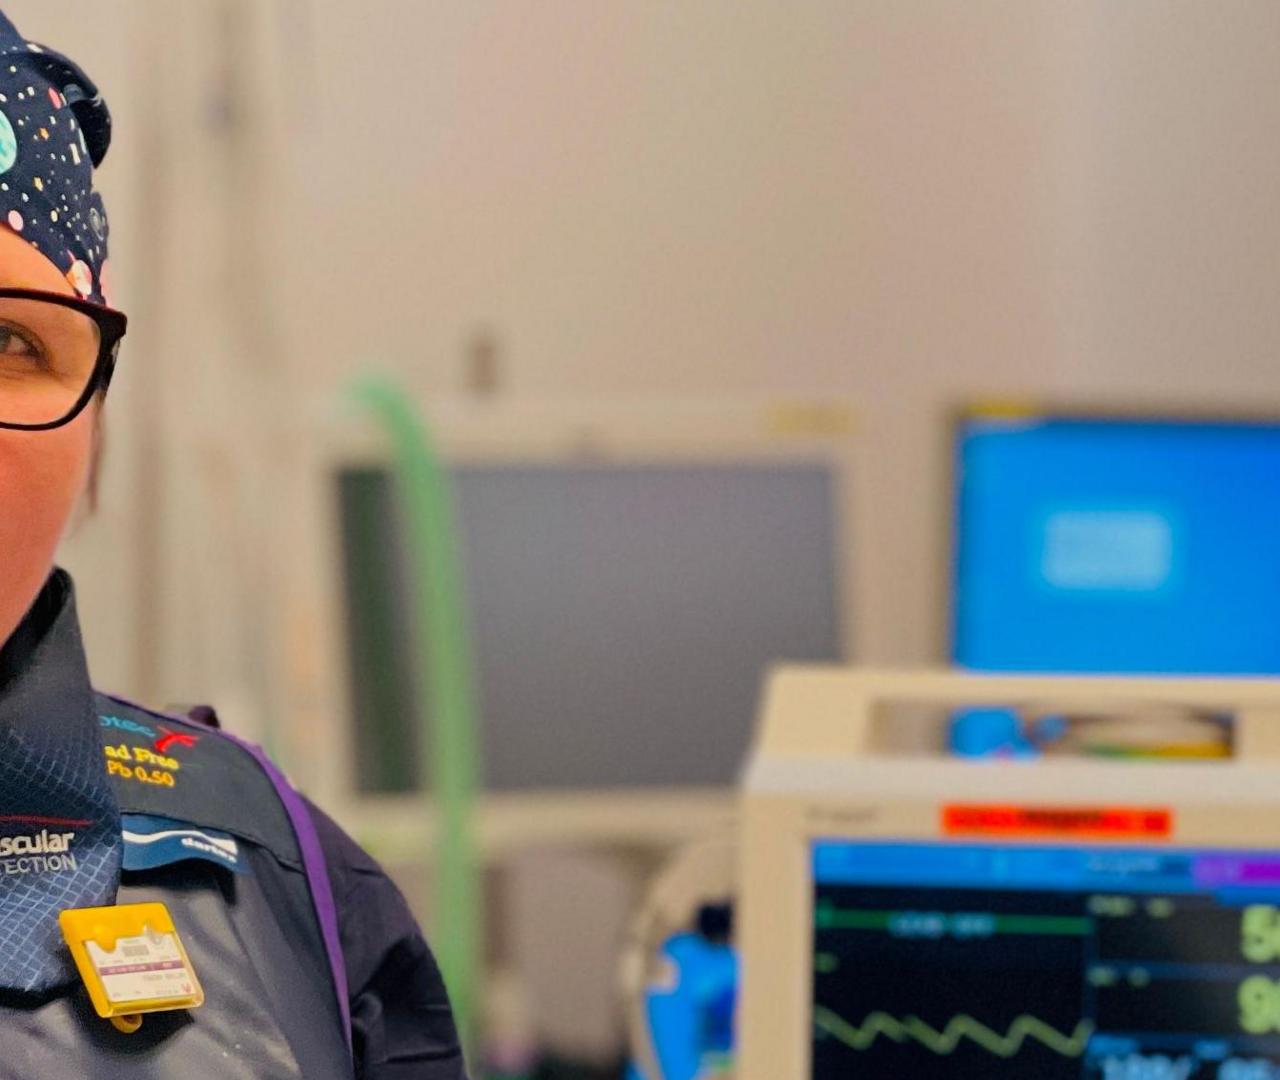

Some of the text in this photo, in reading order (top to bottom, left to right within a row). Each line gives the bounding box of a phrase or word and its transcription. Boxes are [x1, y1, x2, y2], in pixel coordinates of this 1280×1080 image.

[104, 744, 180, 770] ad Free
[107, 760, 176, 787] Pb 0.50
